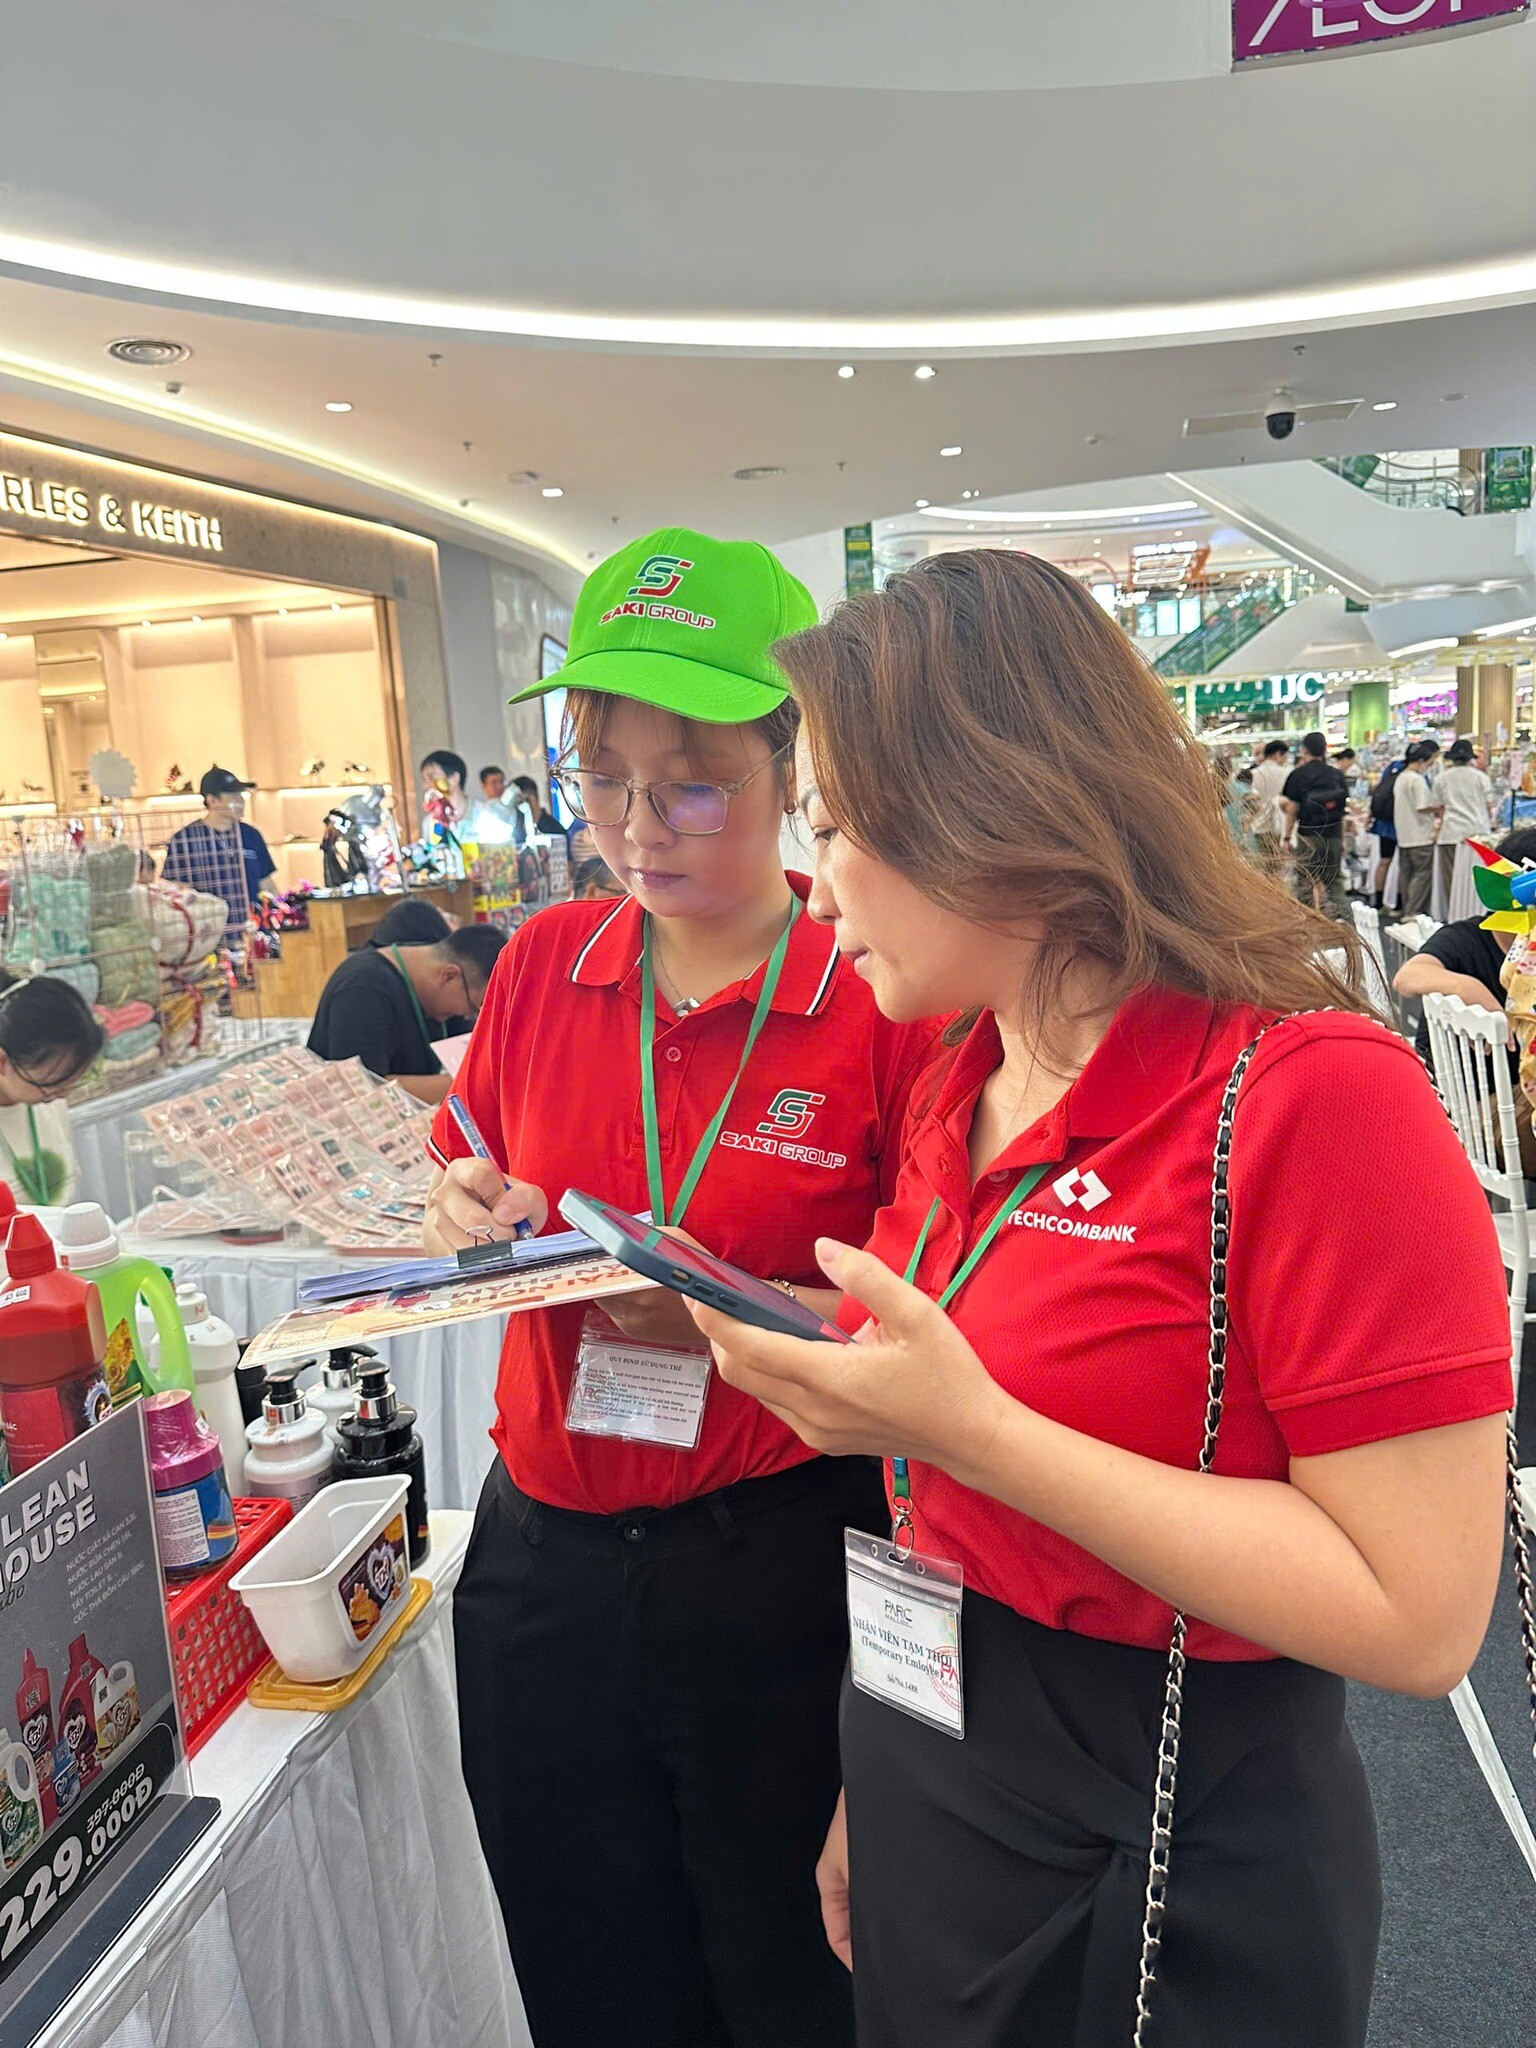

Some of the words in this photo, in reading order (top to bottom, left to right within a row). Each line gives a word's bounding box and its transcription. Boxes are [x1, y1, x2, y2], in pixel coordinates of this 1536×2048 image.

[99, 493, 126, 533] &
[131, 500, 223, 551] KEITH
[600, 602, 645, 625] SAKI
[648, 604, 716, 629] GROUP
[720, 1131, 778, 1155] SAKI
[778, 1142, 847, 1170] GROUP
[568, 1268, 636, 1286] RẢI
[1, 1460, 91, 1549] LEAN
[0, 1494, 97, 1595] OUSE
